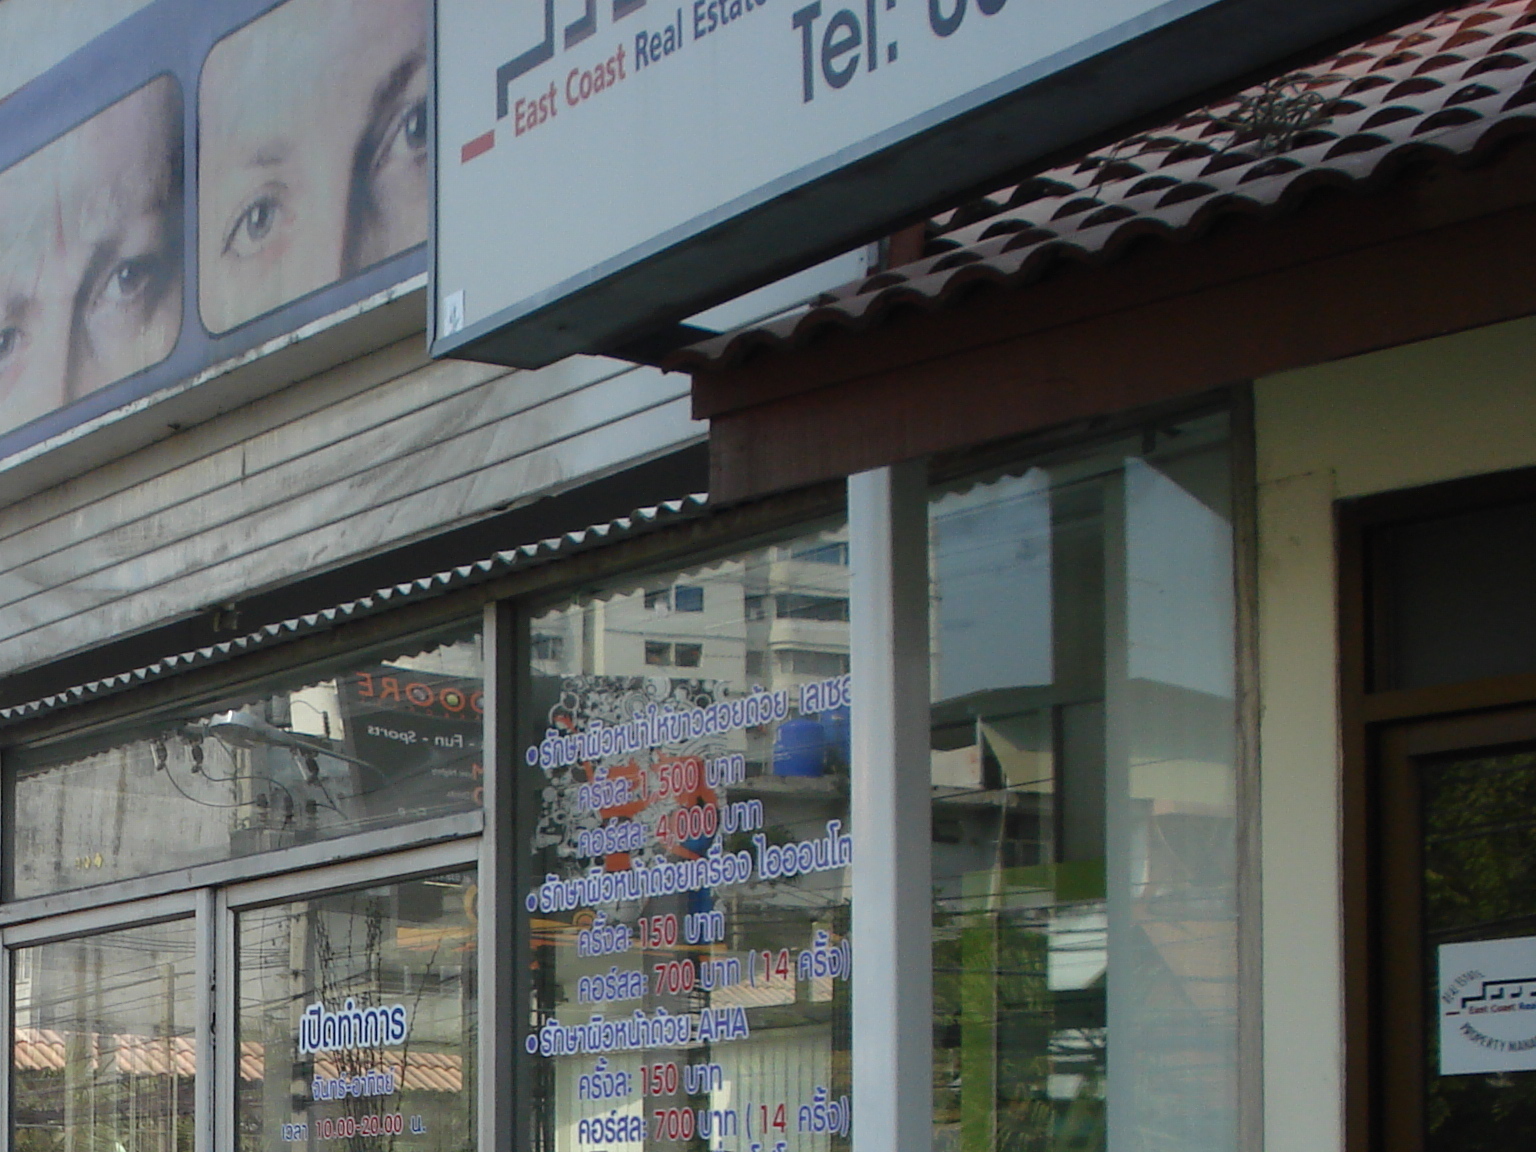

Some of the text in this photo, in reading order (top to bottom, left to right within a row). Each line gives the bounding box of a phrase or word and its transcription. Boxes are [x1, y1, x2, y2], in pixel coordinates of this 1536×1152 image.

[515, 0, 768, 137] East Coast Real Esta
[705, 752, 746, 789] บาท
[655, 802, 716, 851] 4,000
[722, 798, 764, 834] บาท
[639, 913, 678, 949] 150
[684, 911, 725, 945] บาท
[655, 959, 696, 996] 700
[699, 956, 740, 990] บาท
[762, 948, 790, 982] 14
[300, 999, 407, 1053] เปิดทำการ
[697, 1006, 750, 1043] AHA
[639, 1061, 678, 1096] 150
[683, 1061, 723, 1094] บาท
[281, 1122, 308, 1142] เวลา
[315, 1113, 404, 1140] 10.00-20.00
[653, 1106, 695, 1142] 700
[698, 1106, 738, 1140] บาท
[760, 1103, 787, 1136] 14
